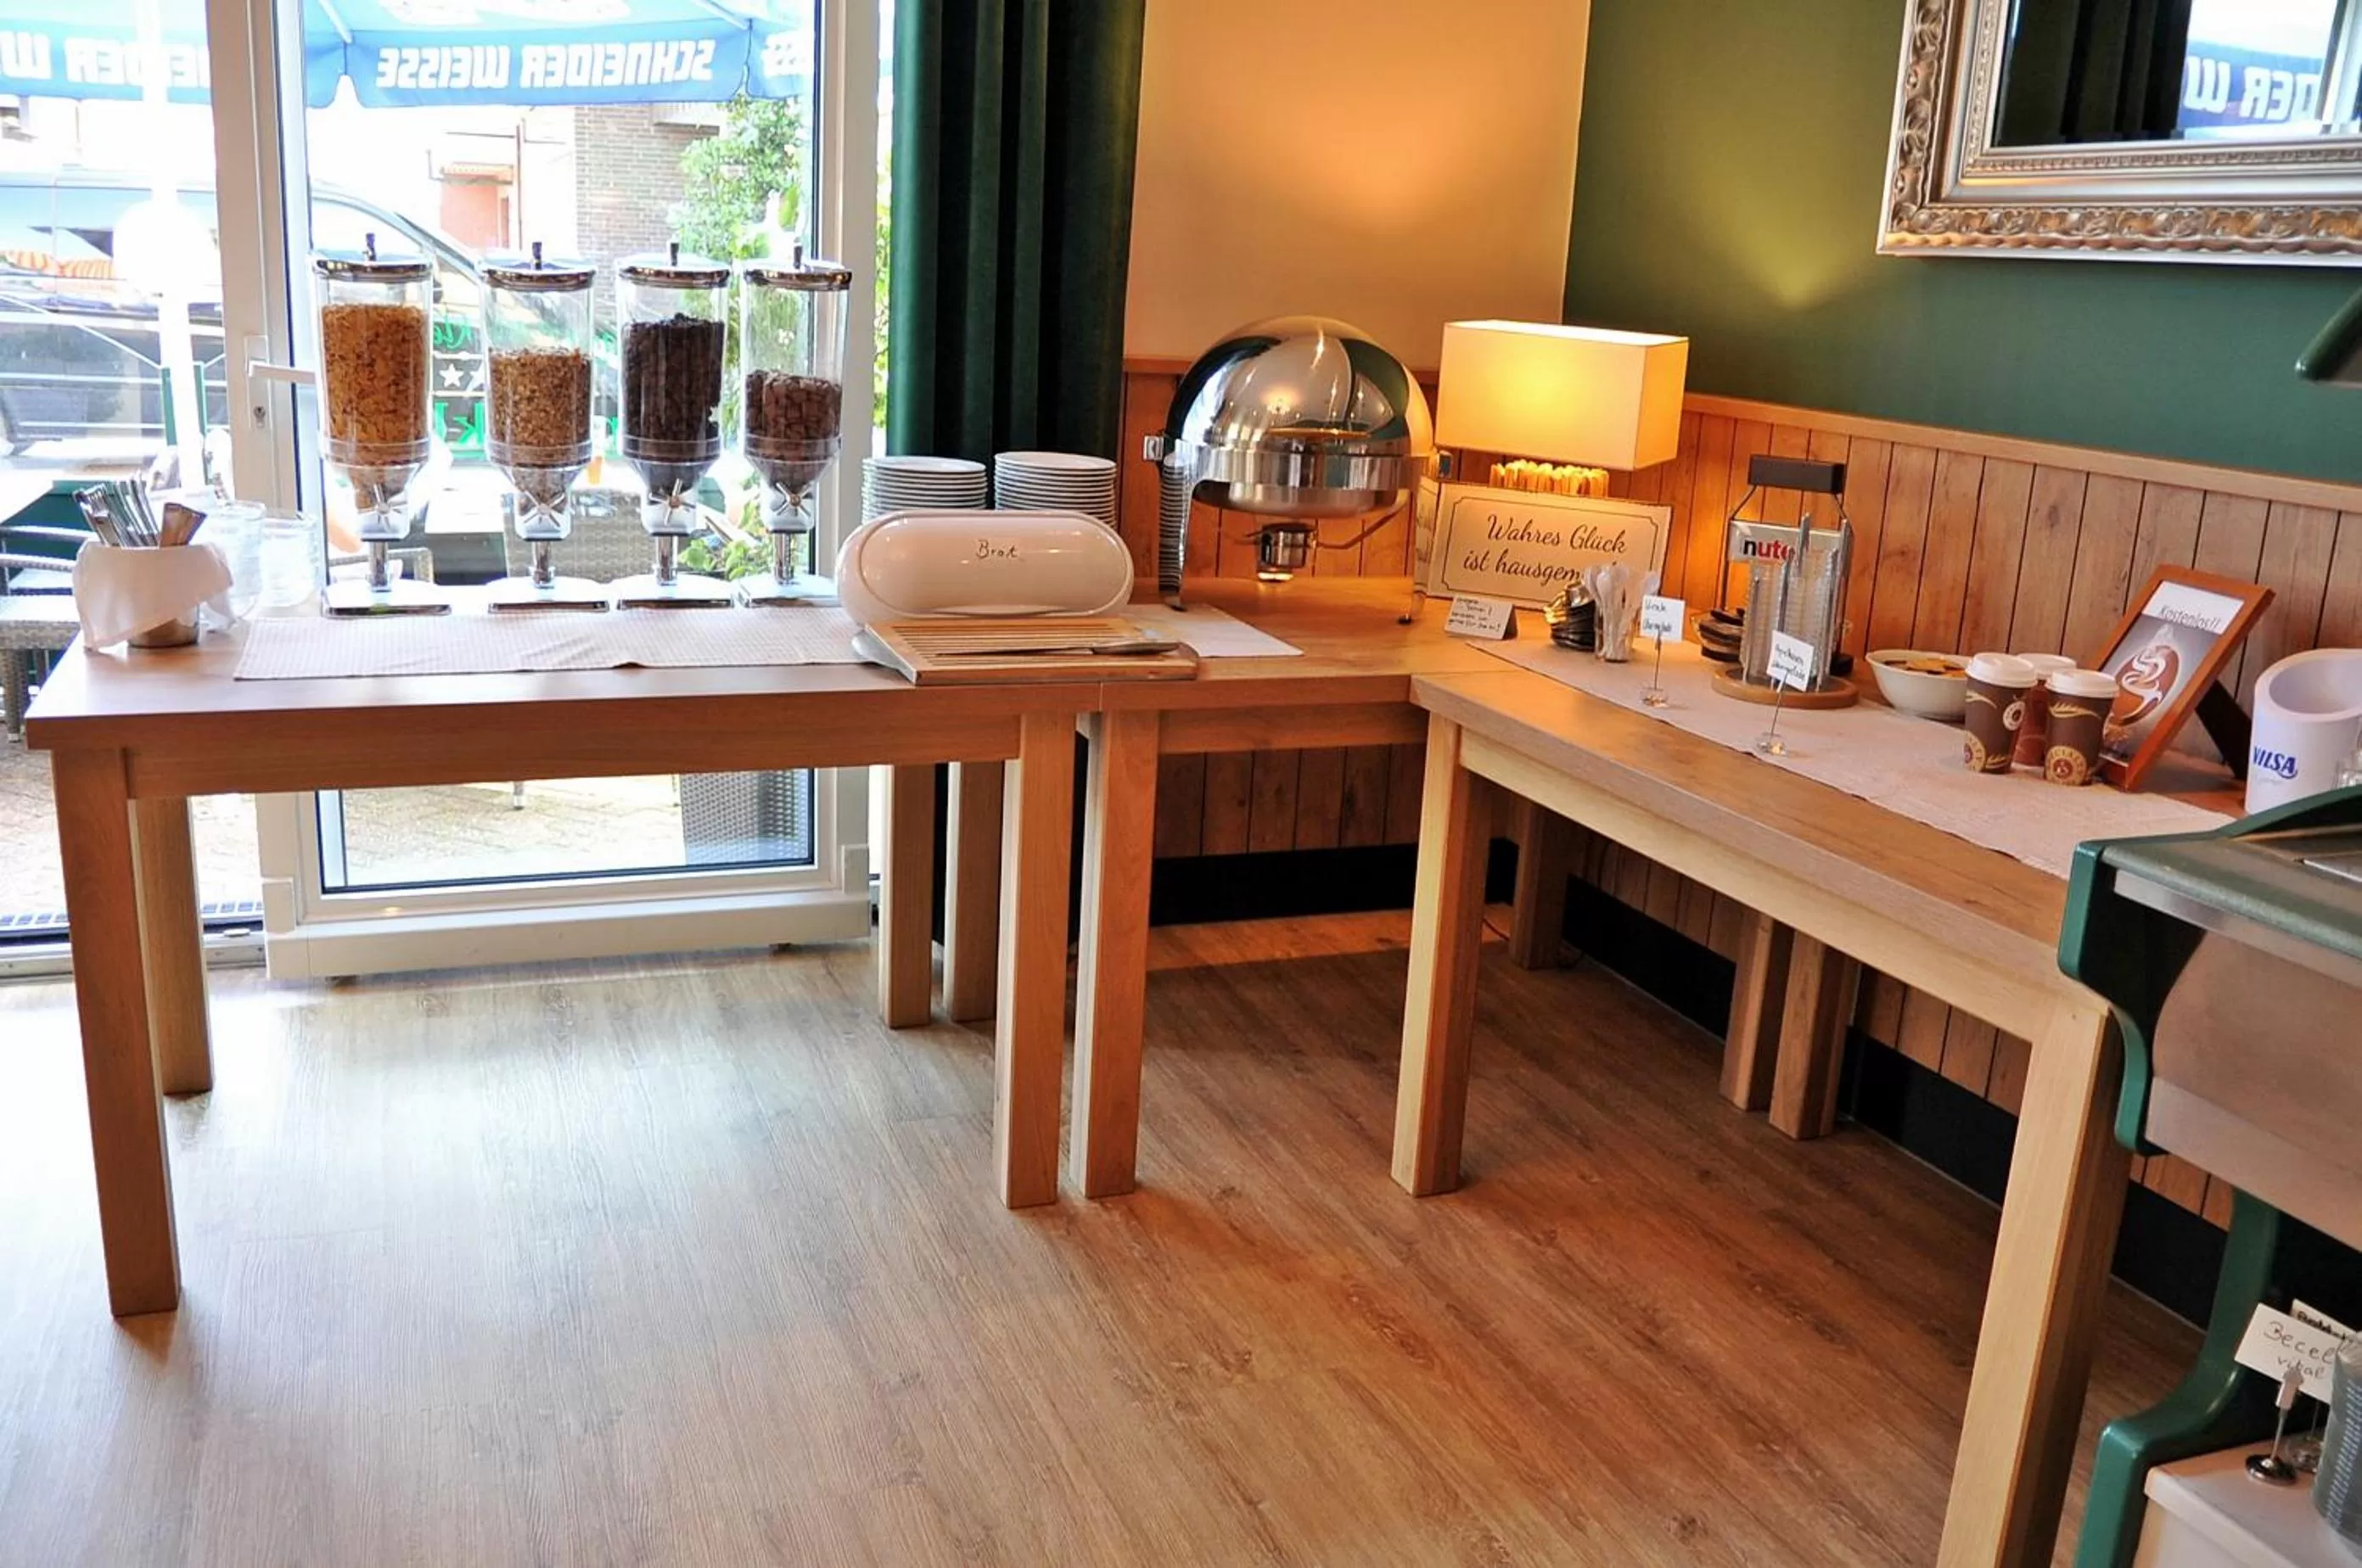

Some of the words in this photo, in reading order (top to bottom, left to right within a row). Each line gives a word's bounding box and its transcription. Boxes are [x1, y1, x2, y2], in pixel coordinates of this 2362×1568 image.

[1487, 515, 1562, 546] Wahres
[1569, 524, 1626, 553] Glück
[1463, 550, 1490, 572] ist
[1495, 548, 1582, 586] hausgem
[2253, 747, 2297, 776] VILSA
[2264, 1320, 2337, 1365] Becel
